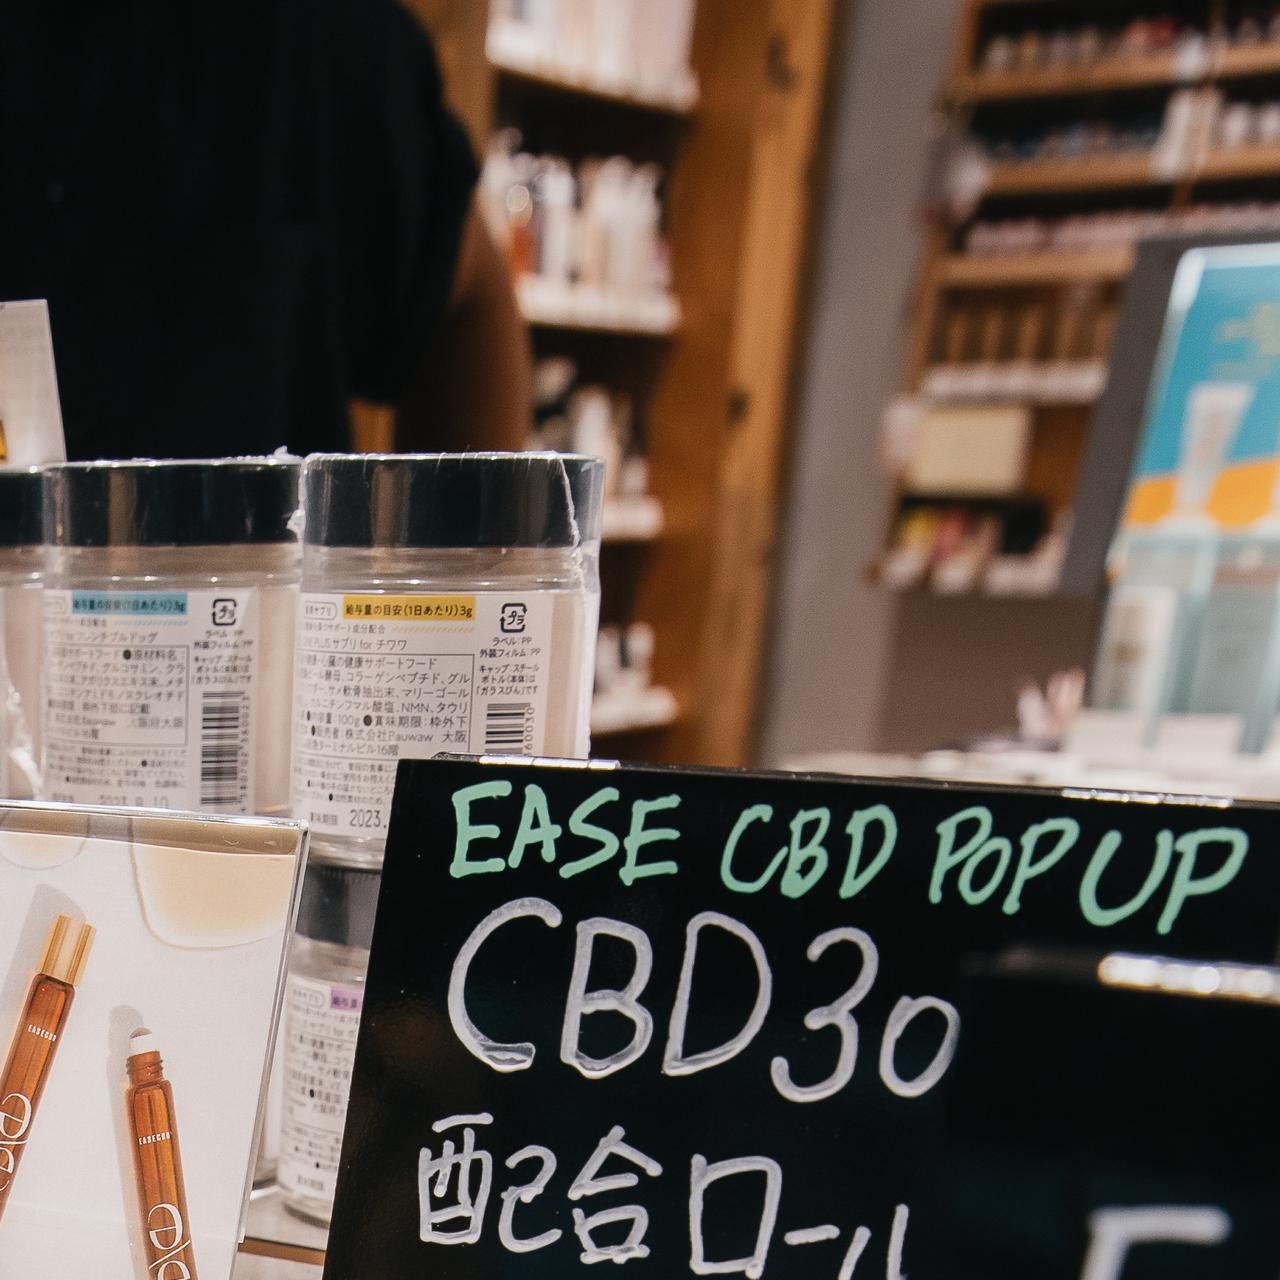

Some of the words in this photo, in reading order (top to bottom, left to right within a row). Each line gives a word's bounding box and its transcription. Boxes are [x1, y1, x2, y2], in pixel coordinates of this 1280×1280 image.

[449, 780, 681, 886] EASE
[721, 803, 897, 899] CBD
[929, 805, 1079, 915] POP
[1080, 826, 1249, 935] UP
